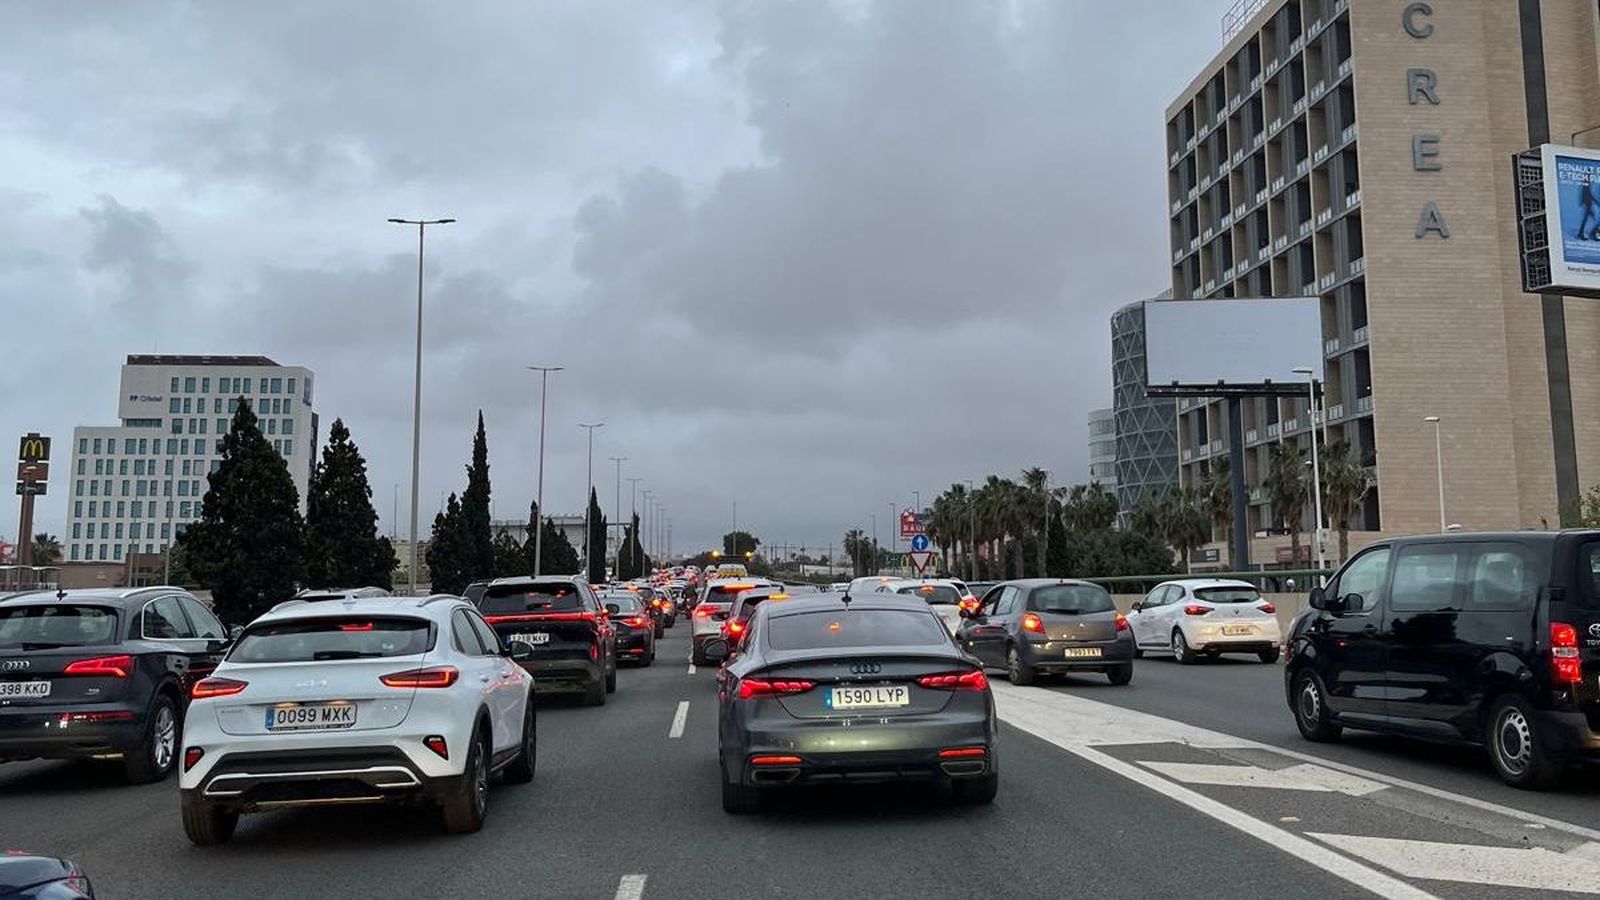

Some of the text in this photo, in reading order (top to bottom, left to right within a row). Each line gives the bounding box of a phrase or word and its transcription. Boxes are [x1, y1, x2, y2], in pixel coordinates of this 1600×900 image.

[1558, 163, 1594, 173] RENAULT
[1560, 171, 1589, 182] E-TECH
[0, 683, 48, 695] 398 KKD
[836, 688, 904, 704] 1590 LYP
[277, 706, 352, 724] 0099 MXK
